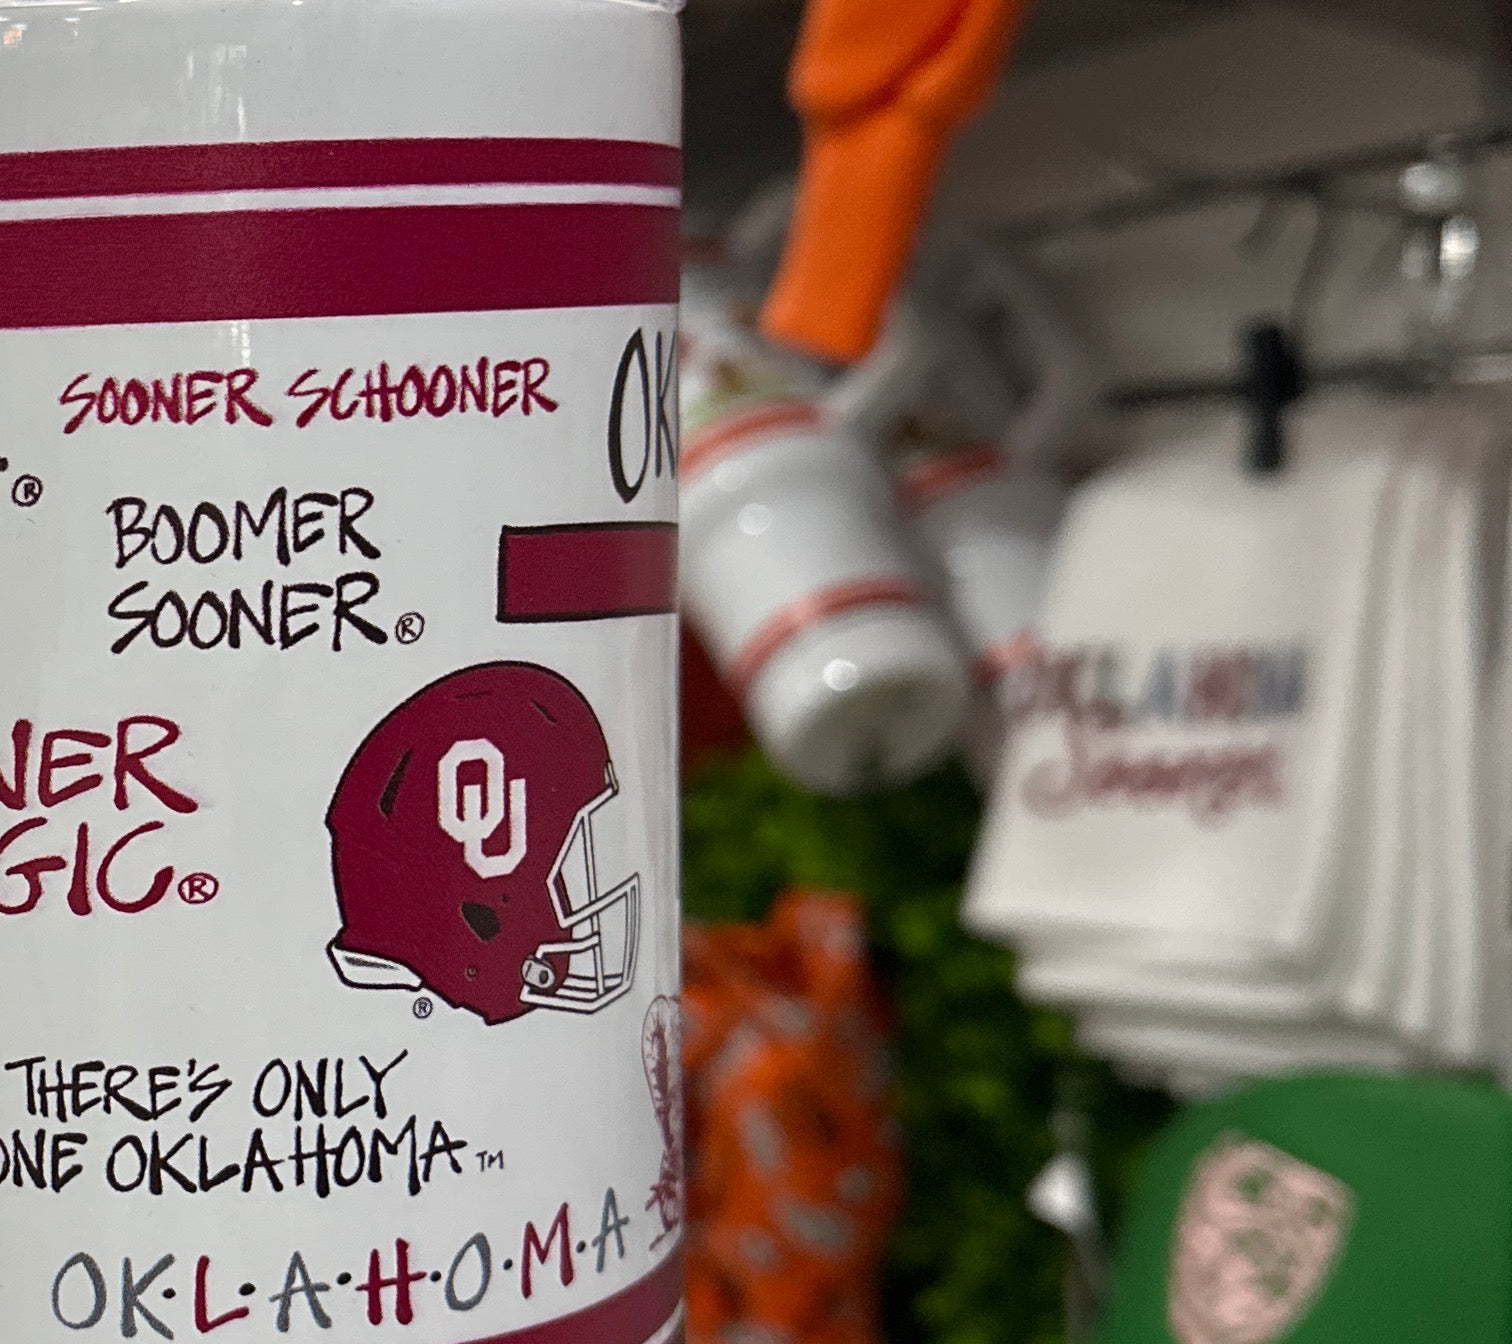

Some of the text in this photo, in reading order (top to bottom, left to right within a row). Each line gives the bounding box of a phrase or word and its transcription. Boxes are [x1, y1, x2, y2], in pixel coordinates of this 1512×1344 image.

[60, 356, 559, 435] SOONER SCHOONER
[104, 486, 382, 568] BOOMER
[438, 738, 527, 879] OU
[5, 1049, 409, 1123] THERE'S ONLY
